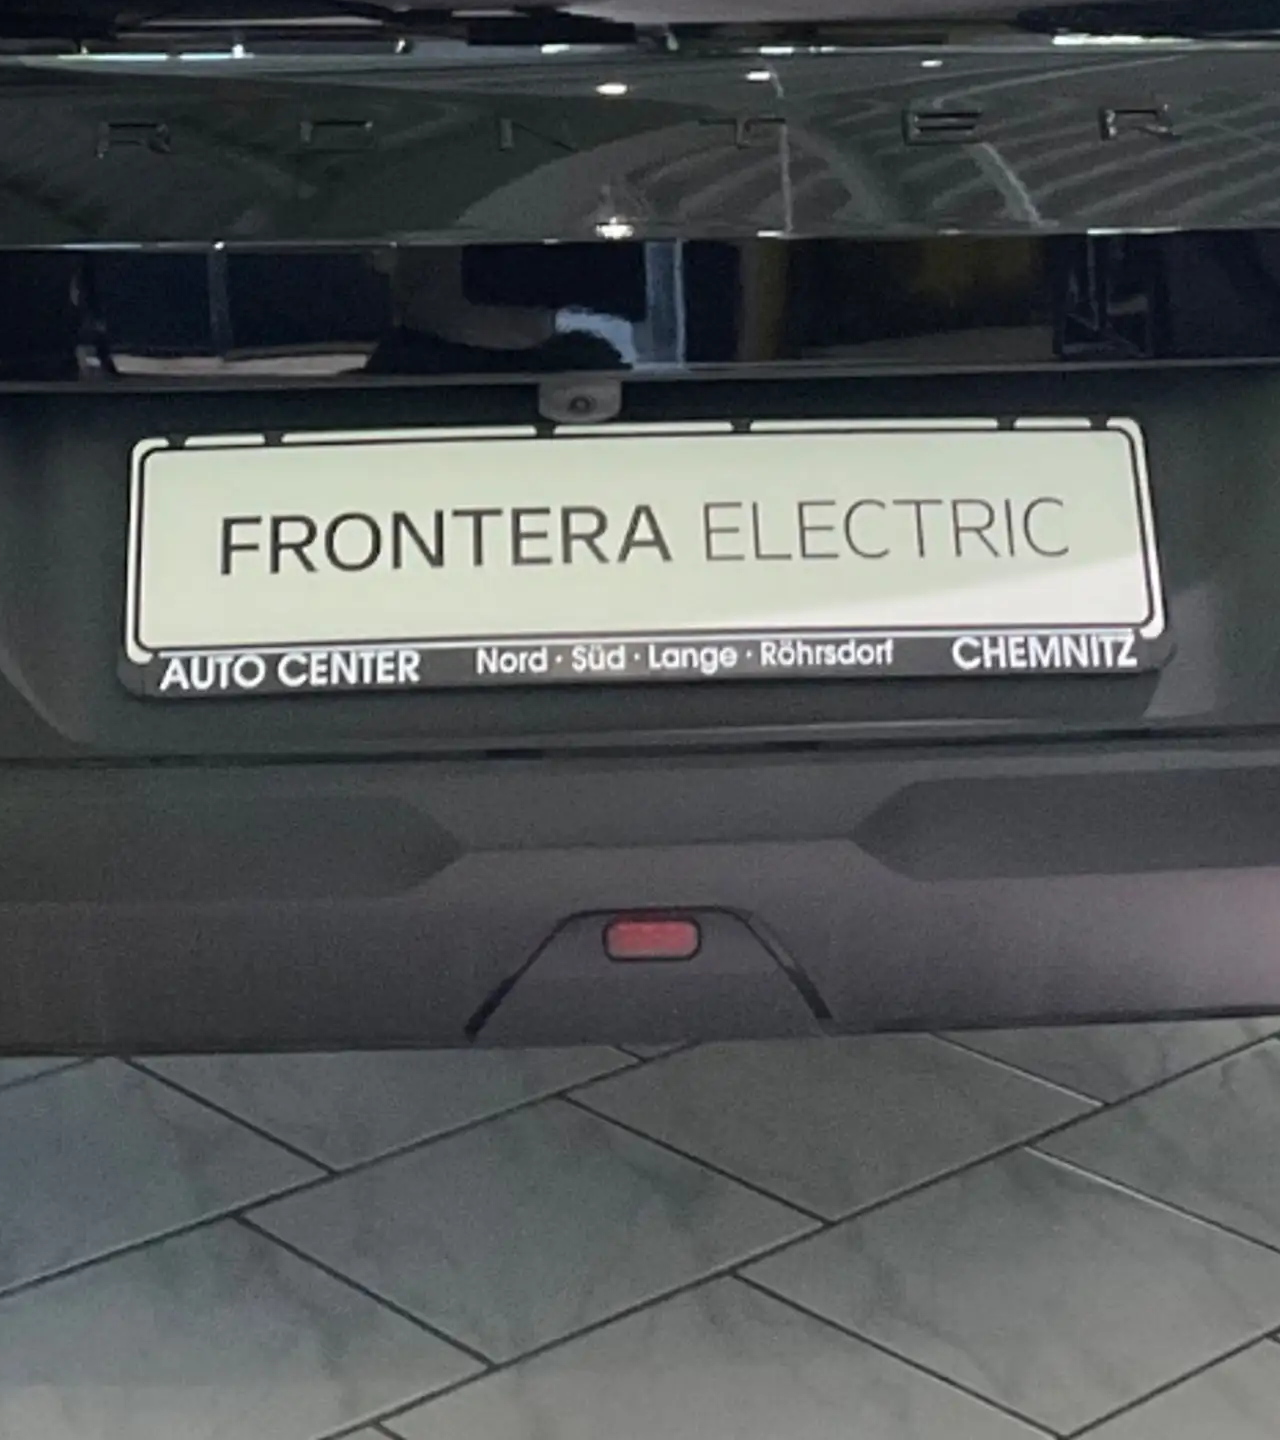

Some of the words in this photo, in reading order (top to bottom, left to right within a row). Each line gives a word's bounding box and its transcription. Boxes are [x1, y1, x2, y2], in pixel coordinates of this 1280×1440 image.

[219, 503, 674, 576] FRONTERA
[703, 496, 1071, 562] ELECTRIC
[159, 653, 266, 691] AUTO
[277, 648, 421, 687] CENTER
[475, 645, 549, 675] Nord
[571, 642, 626, 671] Süd
[647, 642, 738, 676] Lange
[760, 637, 895, 667] Röhrsdorf
[951, 633, 1139, 671] CHEMNITZ
